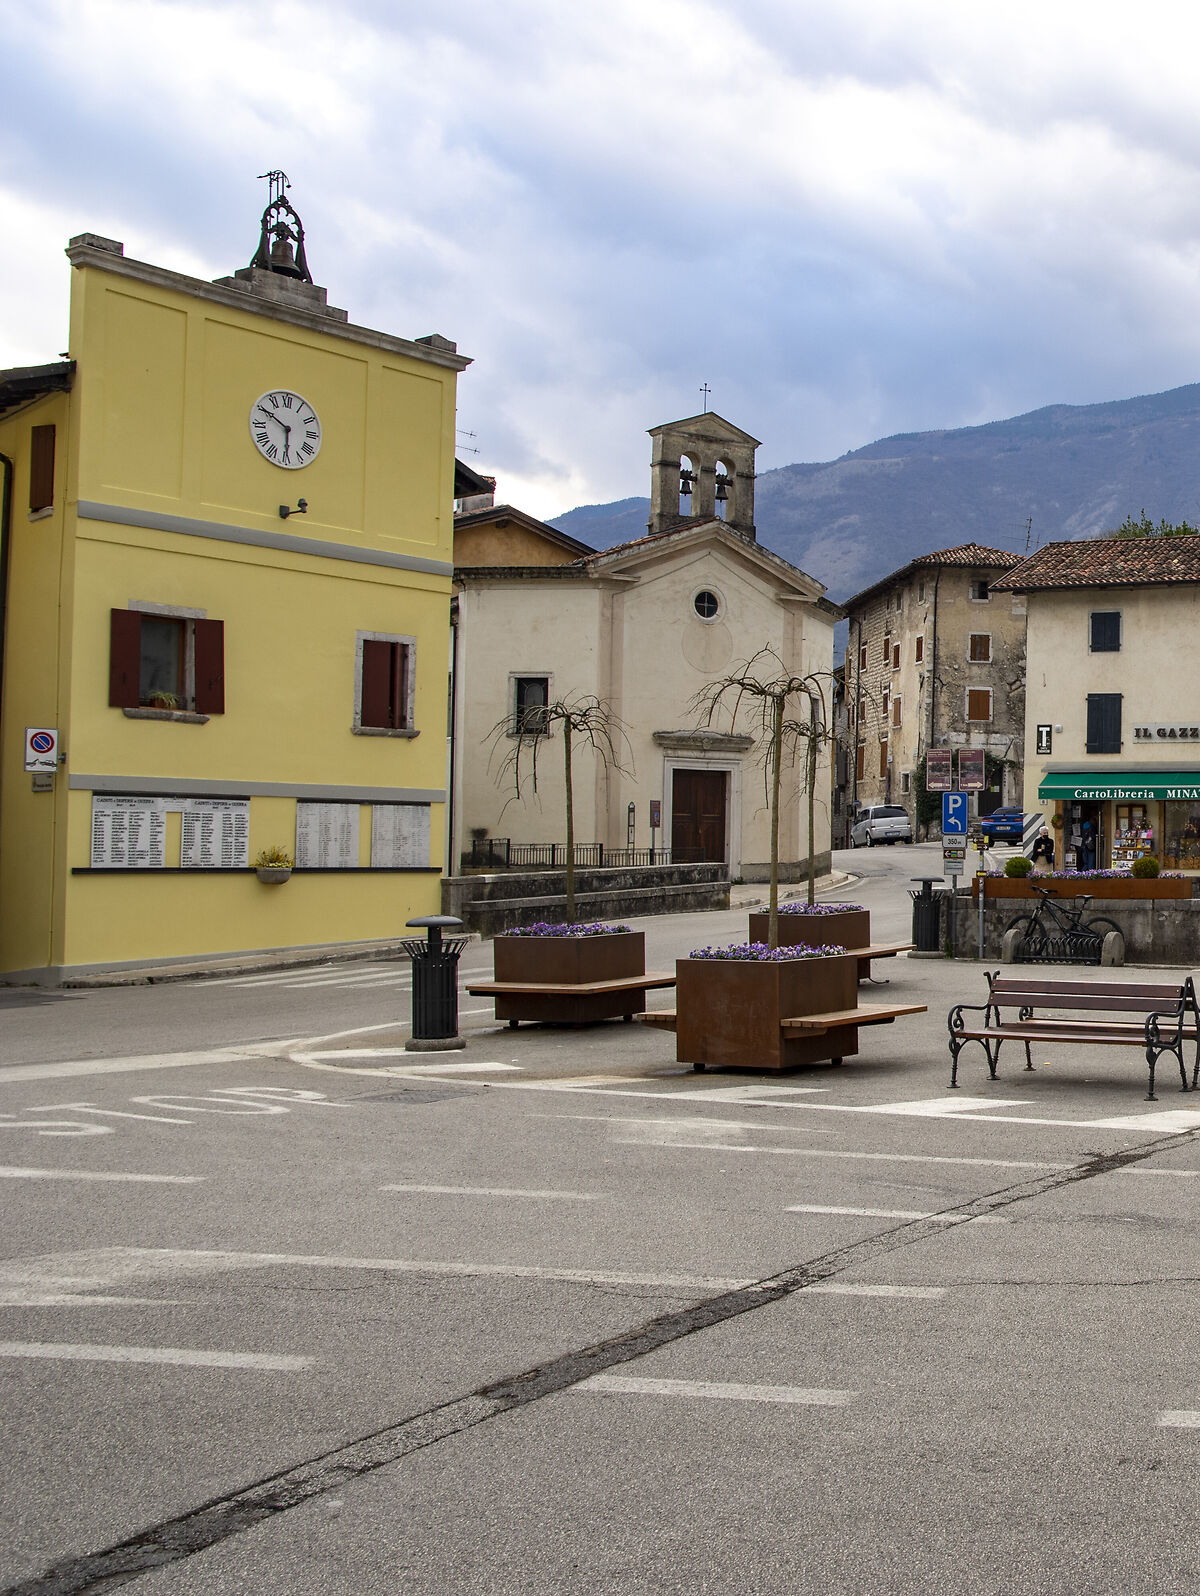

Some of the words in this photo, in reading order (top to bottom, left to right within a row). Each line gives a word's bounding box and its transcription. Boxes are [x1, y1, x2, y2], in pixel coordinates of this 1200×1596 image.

[1134, 727, 1152, 739] IL
[1074, 789, 1155, 799] CartoLibreria
[948, 795, 962, 815] P
